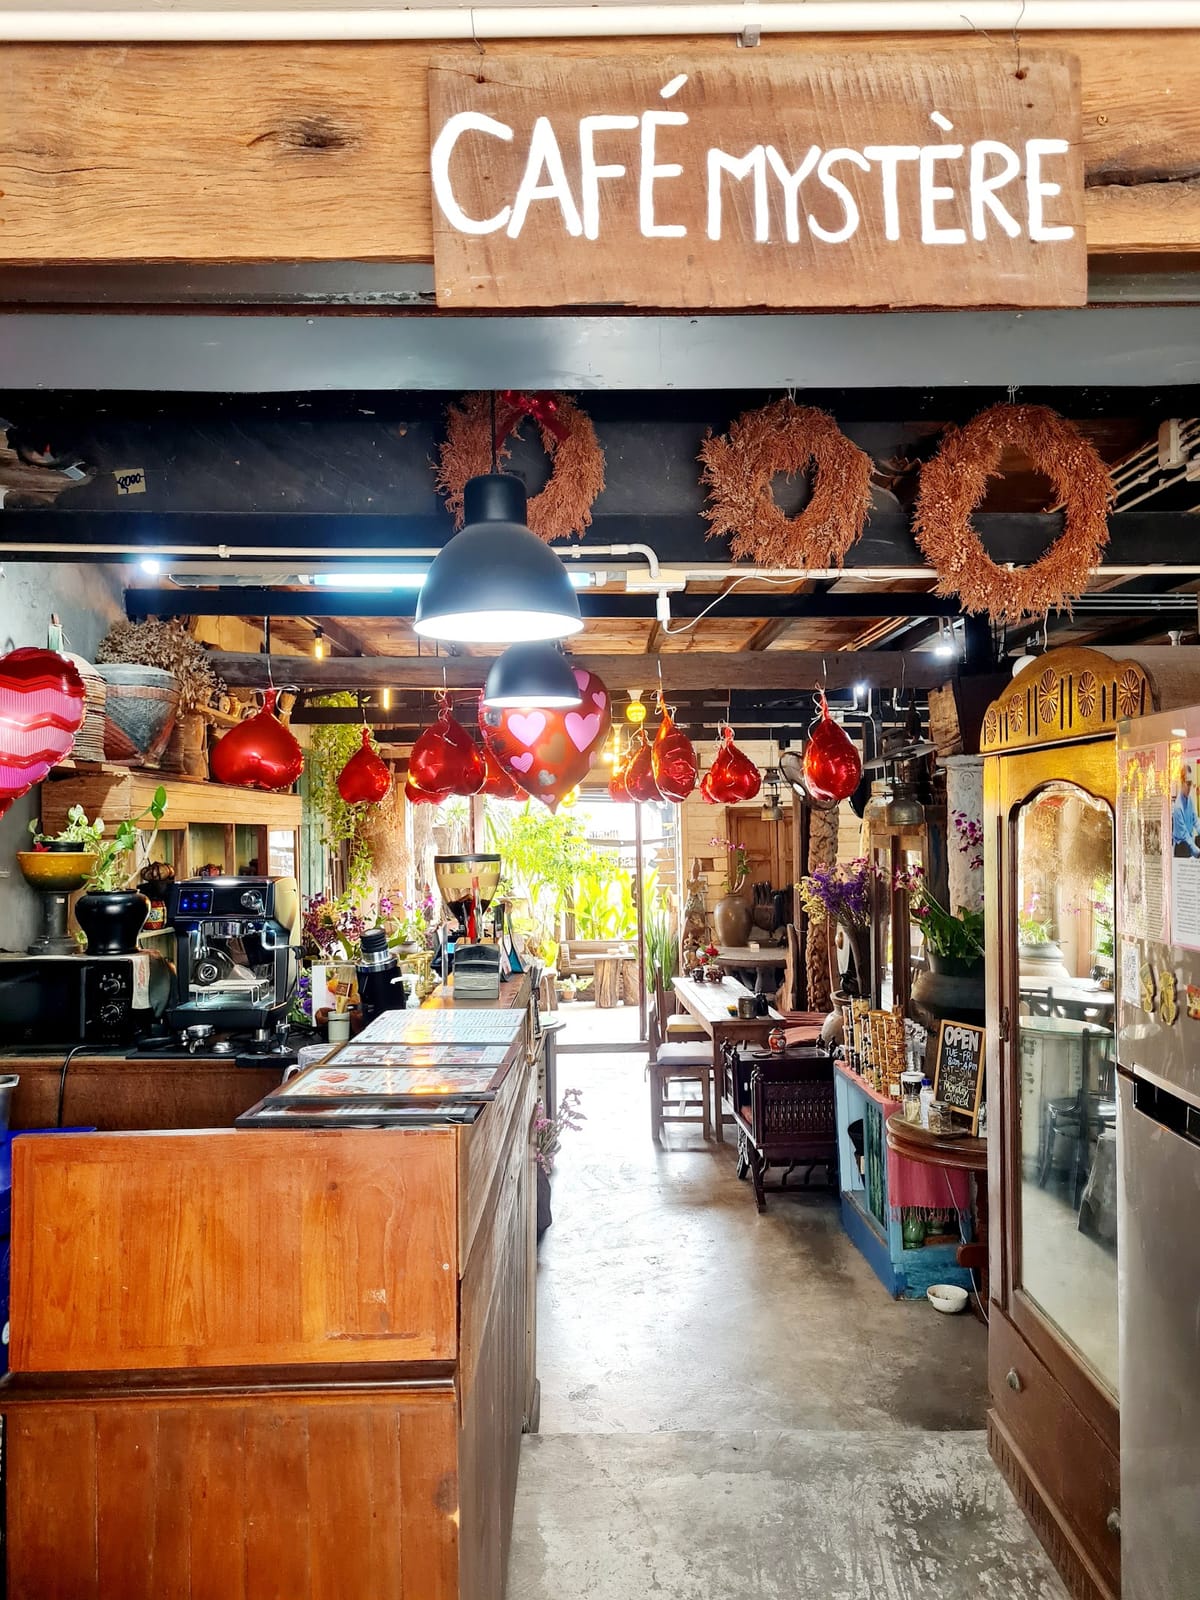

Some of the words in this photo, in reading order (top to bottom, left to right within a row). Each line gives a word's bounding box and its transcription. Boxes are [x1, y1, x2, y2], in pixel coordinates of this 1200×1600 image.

[431, 74, 689, 240] CAFÉ
[707, 110, 1074, 245] MYSTÈRE
[944, 1026, 979, 1052] OPEN
